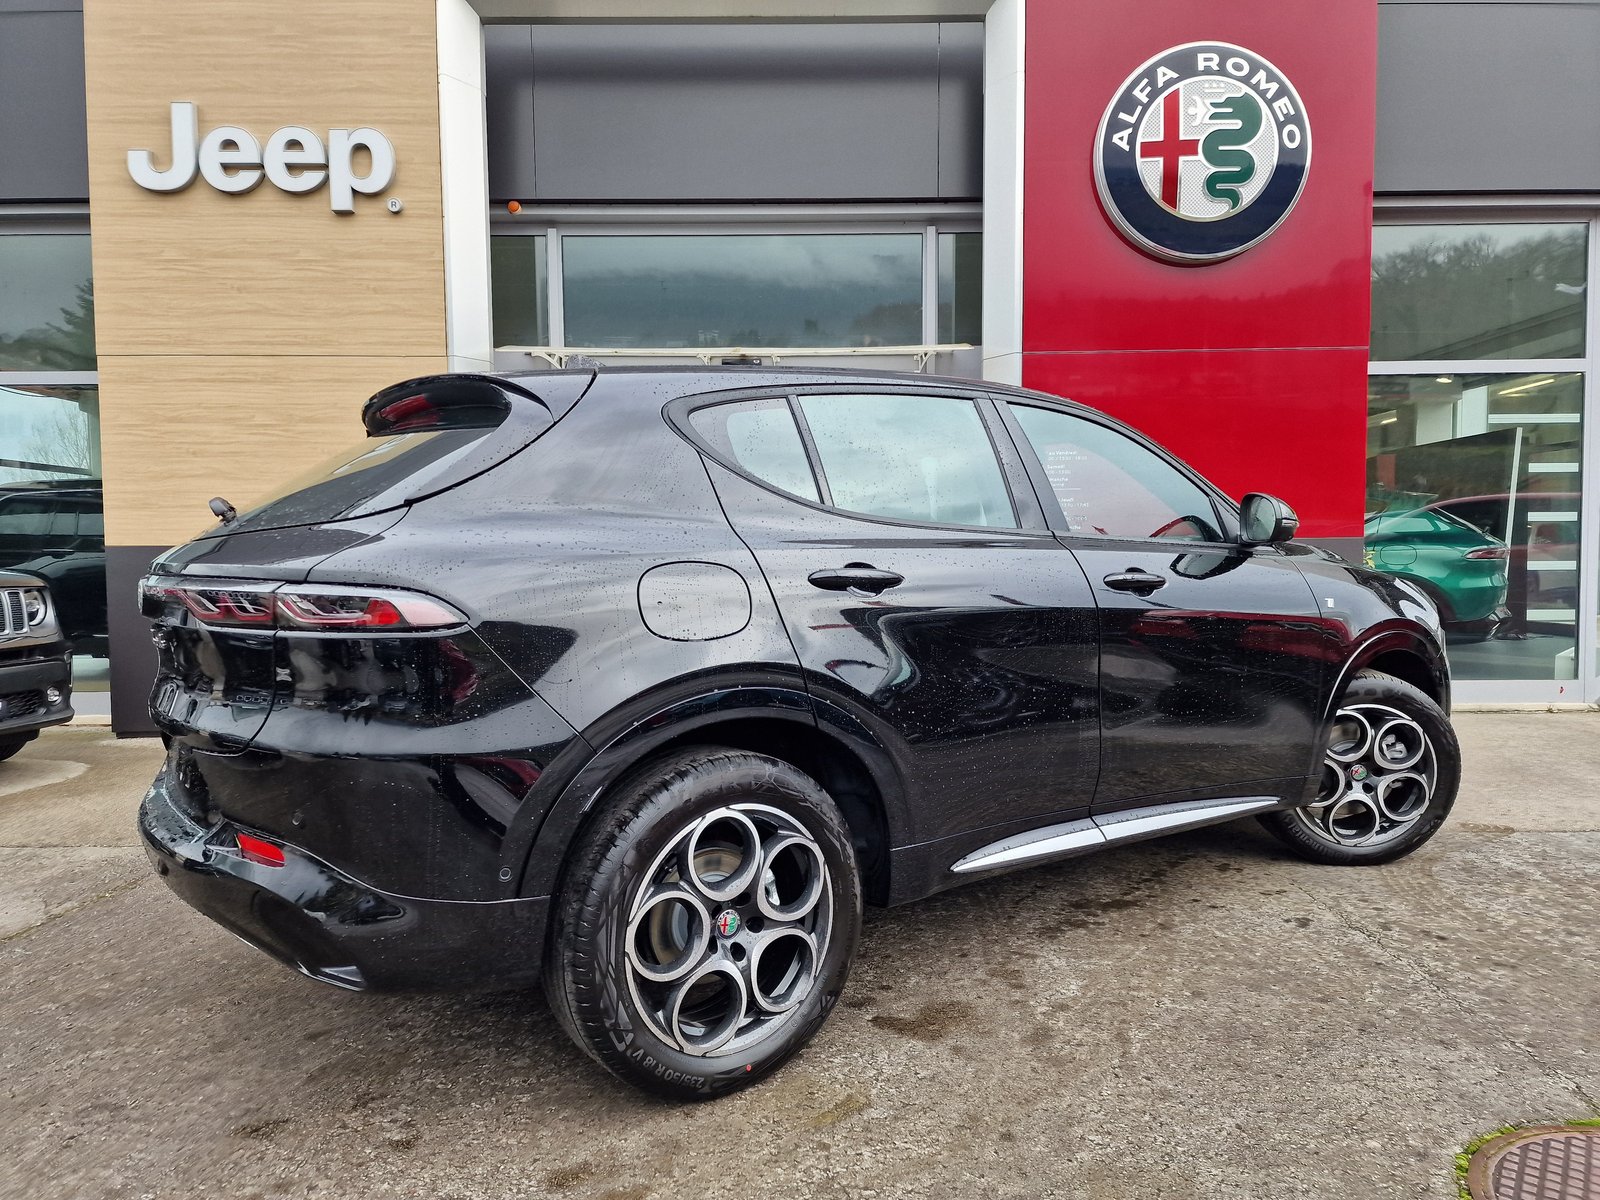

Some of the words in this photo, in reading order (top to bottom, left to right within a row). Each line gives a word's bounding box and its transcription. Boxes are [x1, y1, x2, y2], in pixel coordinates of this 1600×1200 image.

[1111, 65, 1180, 152] ALFA
[1197, 53, 1301, 149] ROMEO
[127, 101, 397, 214] Jeep
